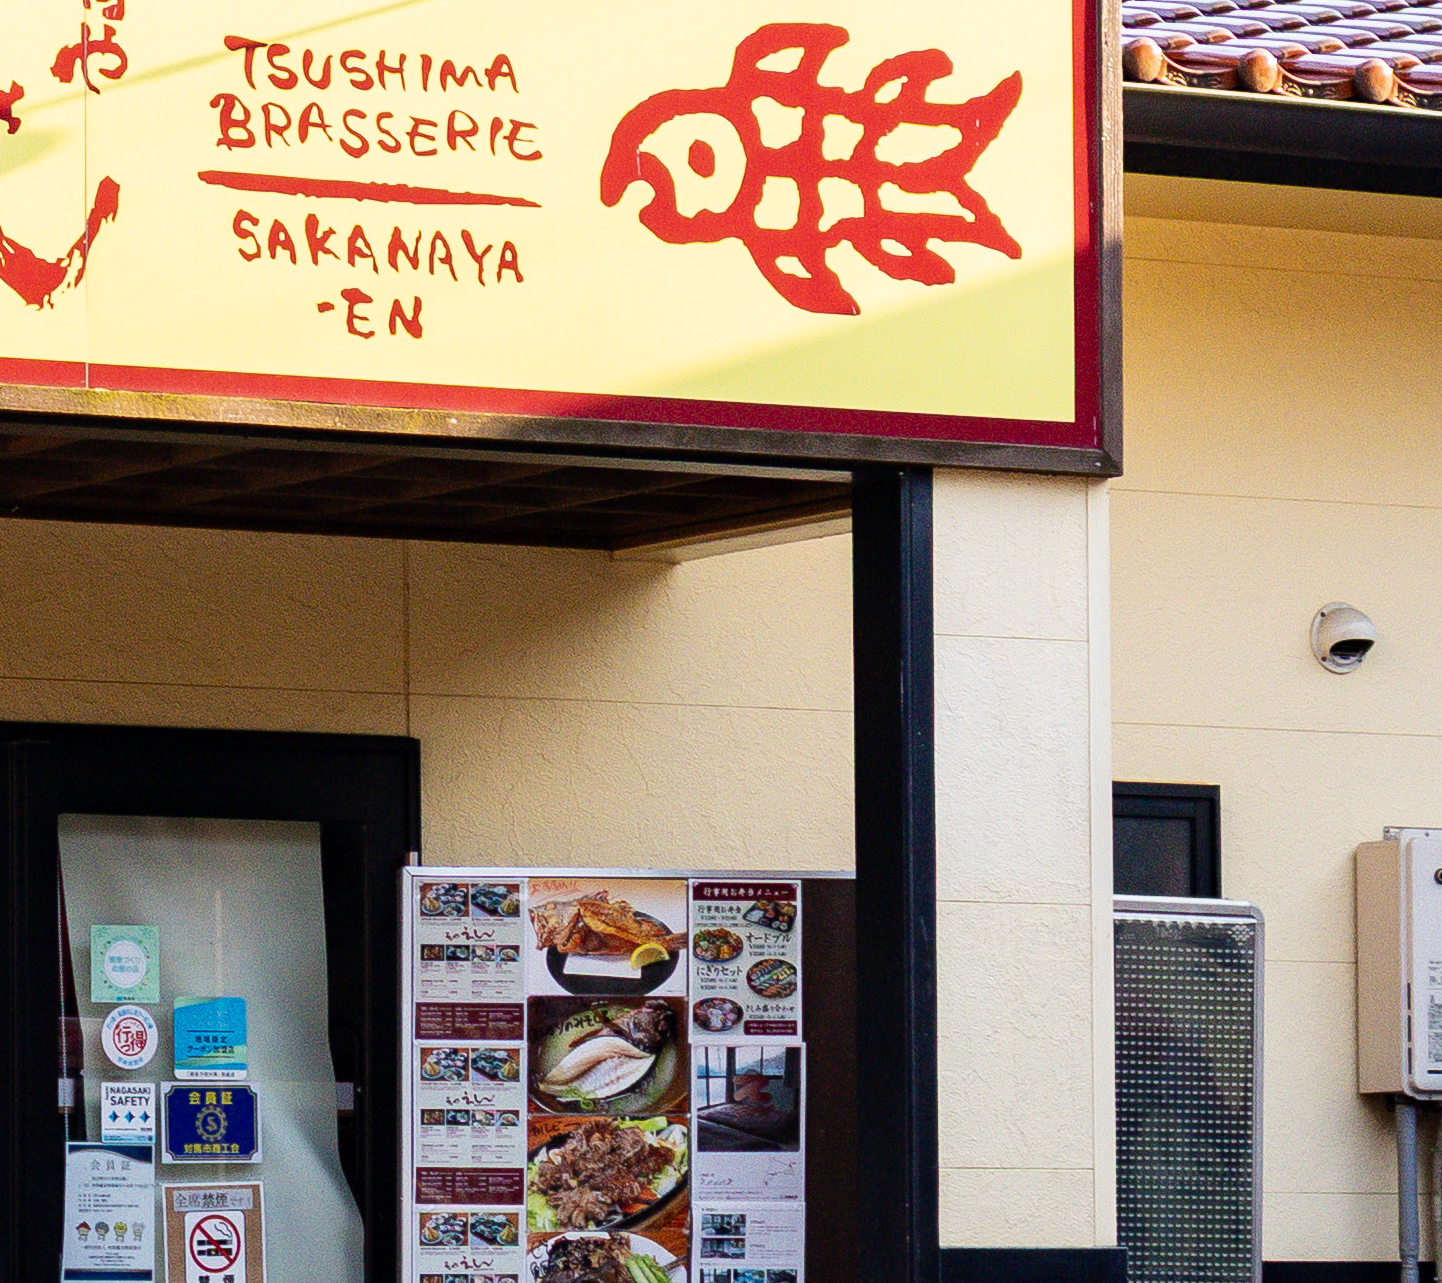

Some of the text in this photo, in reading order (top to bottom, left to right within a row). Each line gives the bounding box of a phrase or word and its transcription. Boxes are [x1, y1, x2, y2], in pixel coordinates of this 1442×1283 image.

[223, 34, 518, 92] TSUSHIMA
[210, 90, 545, 163] BRASSERIE
[232, 208, 526, 286] SAKANAYA
[745, 931, 792, 944] オードブル
[696, 964, 743, 977] にぎりセット
[109, 1086, 151, 1095] NAGASAKI
[110, 1095, 151, 1106] SAFETY
[188, 1091, 233, 1105] 会員証
